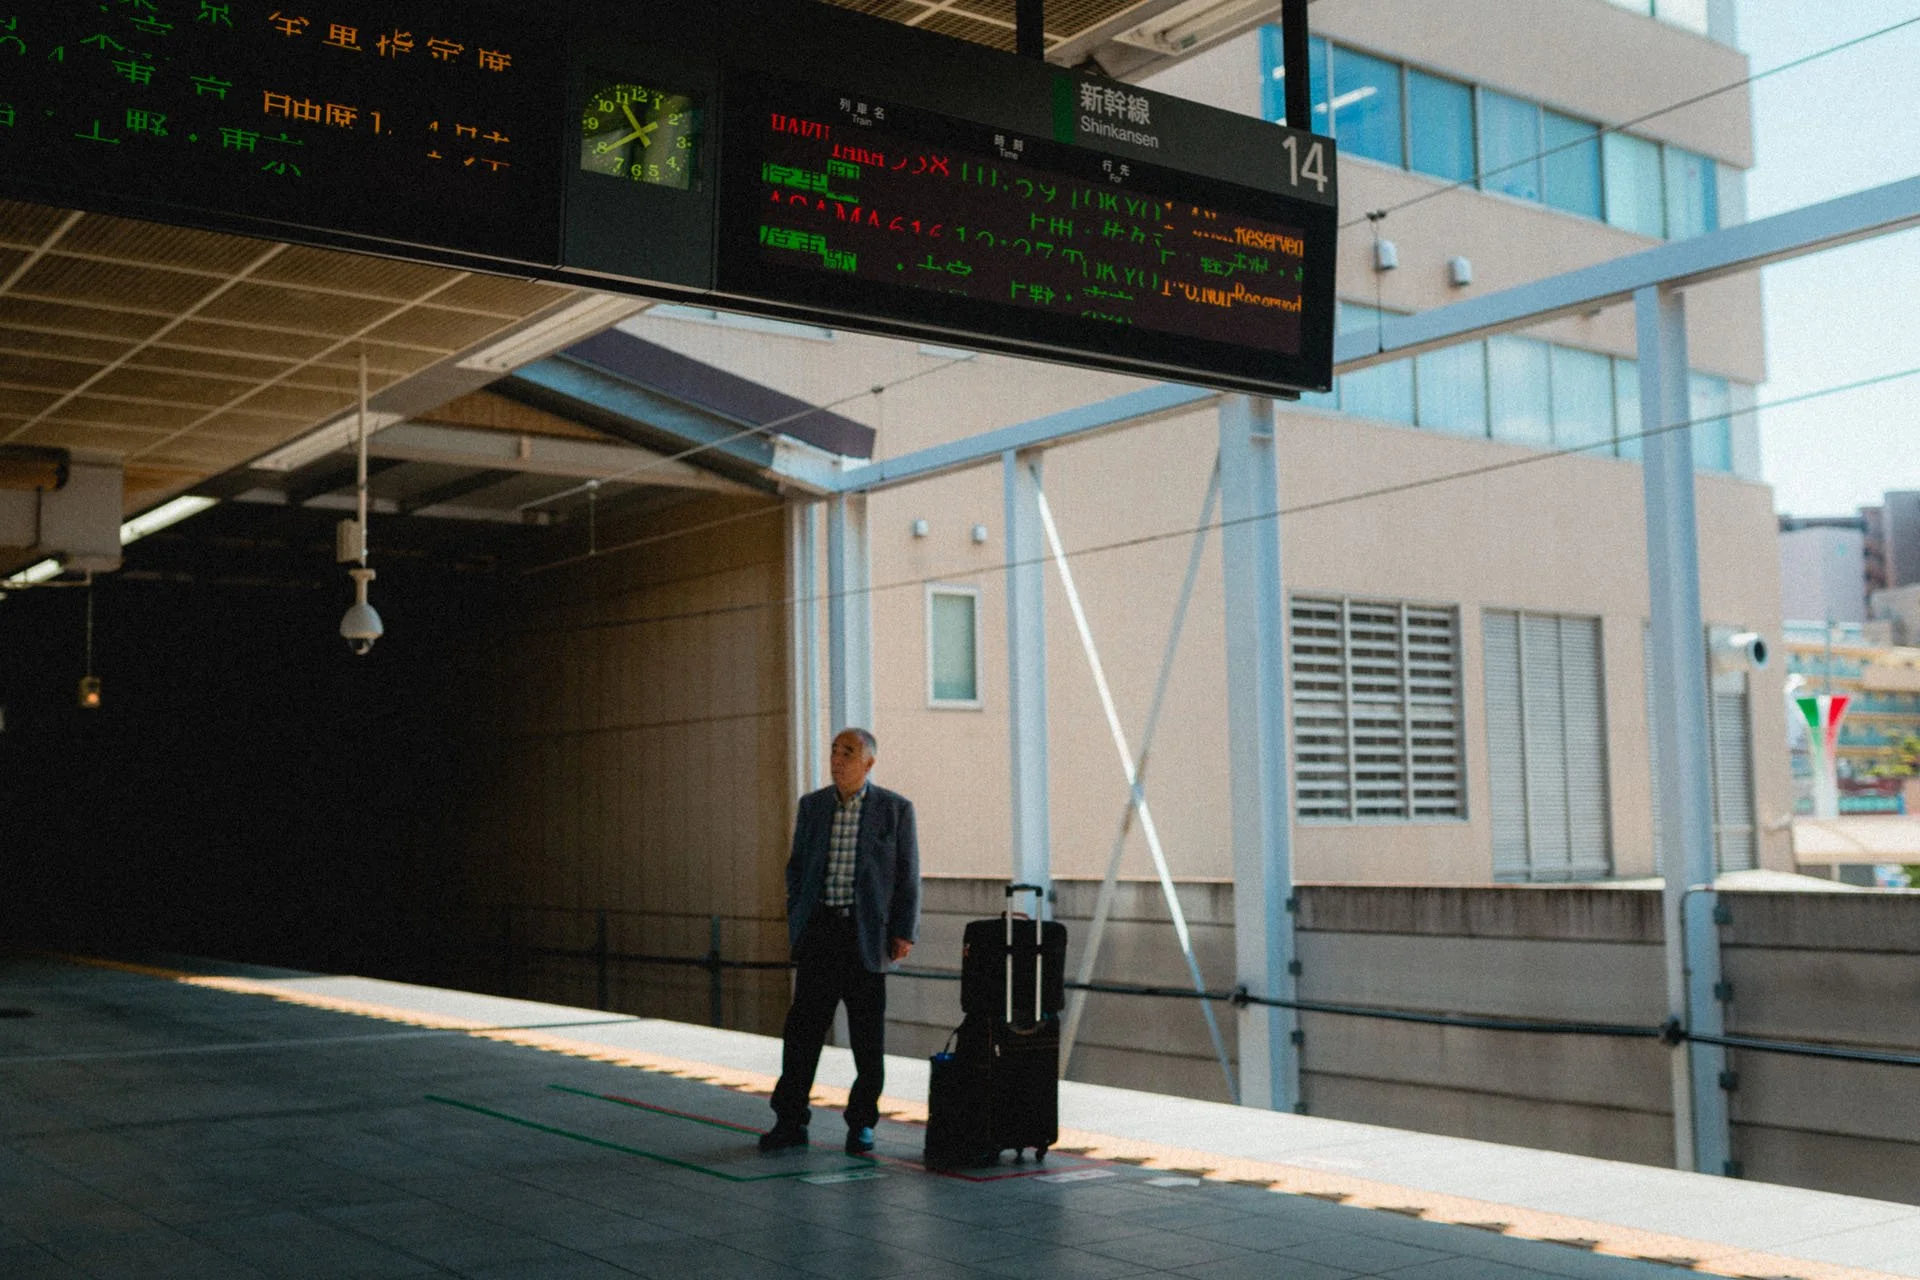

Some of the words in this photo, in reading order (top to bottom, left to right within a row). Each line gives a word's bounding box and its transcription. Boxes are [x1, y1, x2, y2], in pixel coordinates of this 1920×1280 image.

[616, 91, 629, 105] 11
[631, 88, 648, 102] 12
[599, 99, 615, 113] 10
[653, 98, 661, 110] 1
[840, 97, 885, 120] 列車名
[1080, 82, 1150, 125] 新幹線
[588, 117, 599, 130] 9
[668, 113, 679, 126] 2
[852, 113, 872, 126] Train
[1080, 115, 1159, 149] Shinkansen
[676, 136, 687, 149] 3
[614, 157, 624, 173] 7
[666, 156, 677, 168] 4
[1102, 160, 1130, 176] 行先
[1281, 135, 1328, 193] 14
[631, 164, 642, 177] 6
[648, 164, 659, 177] 5
